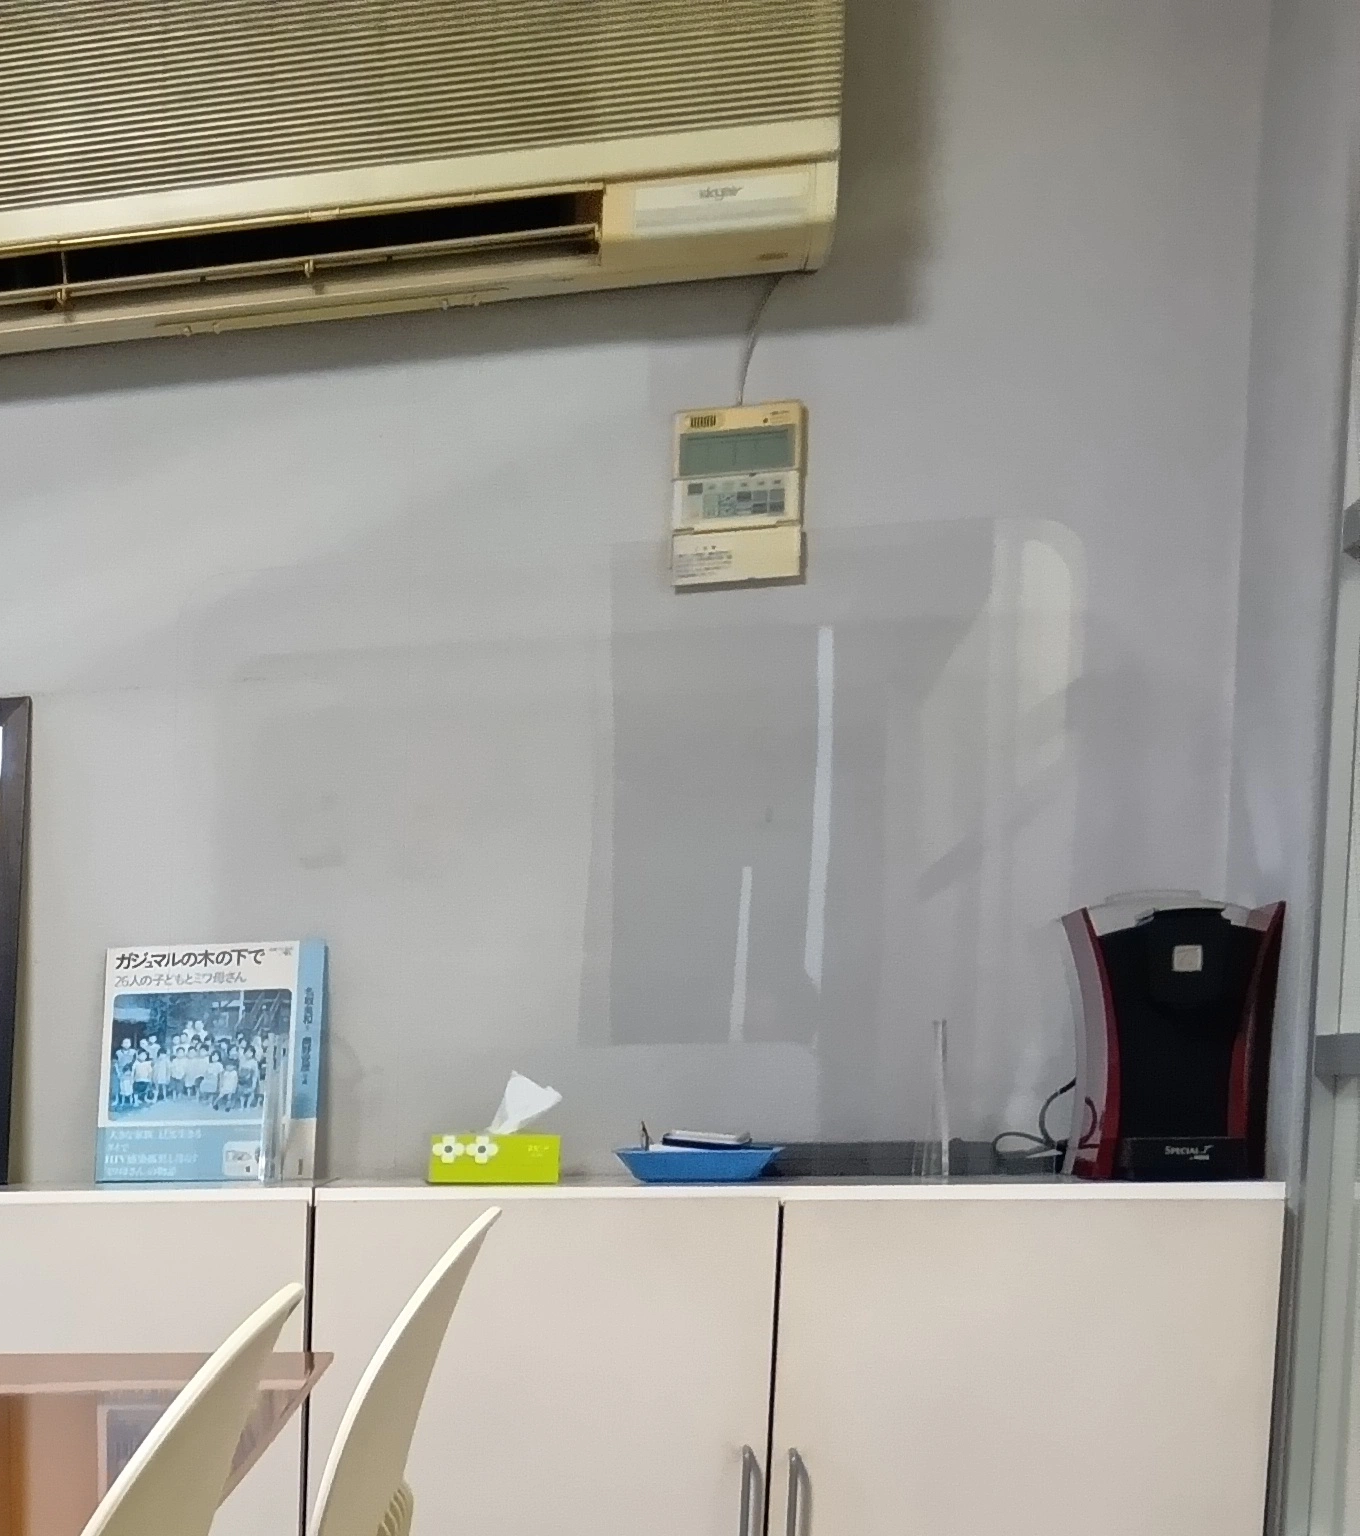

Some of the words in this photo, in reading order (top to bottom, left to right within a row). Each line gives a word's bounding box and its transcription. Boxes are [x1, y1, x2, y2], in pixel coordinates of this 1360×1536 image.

[115, 948, 266, 970] ガジュマルの木の下で
